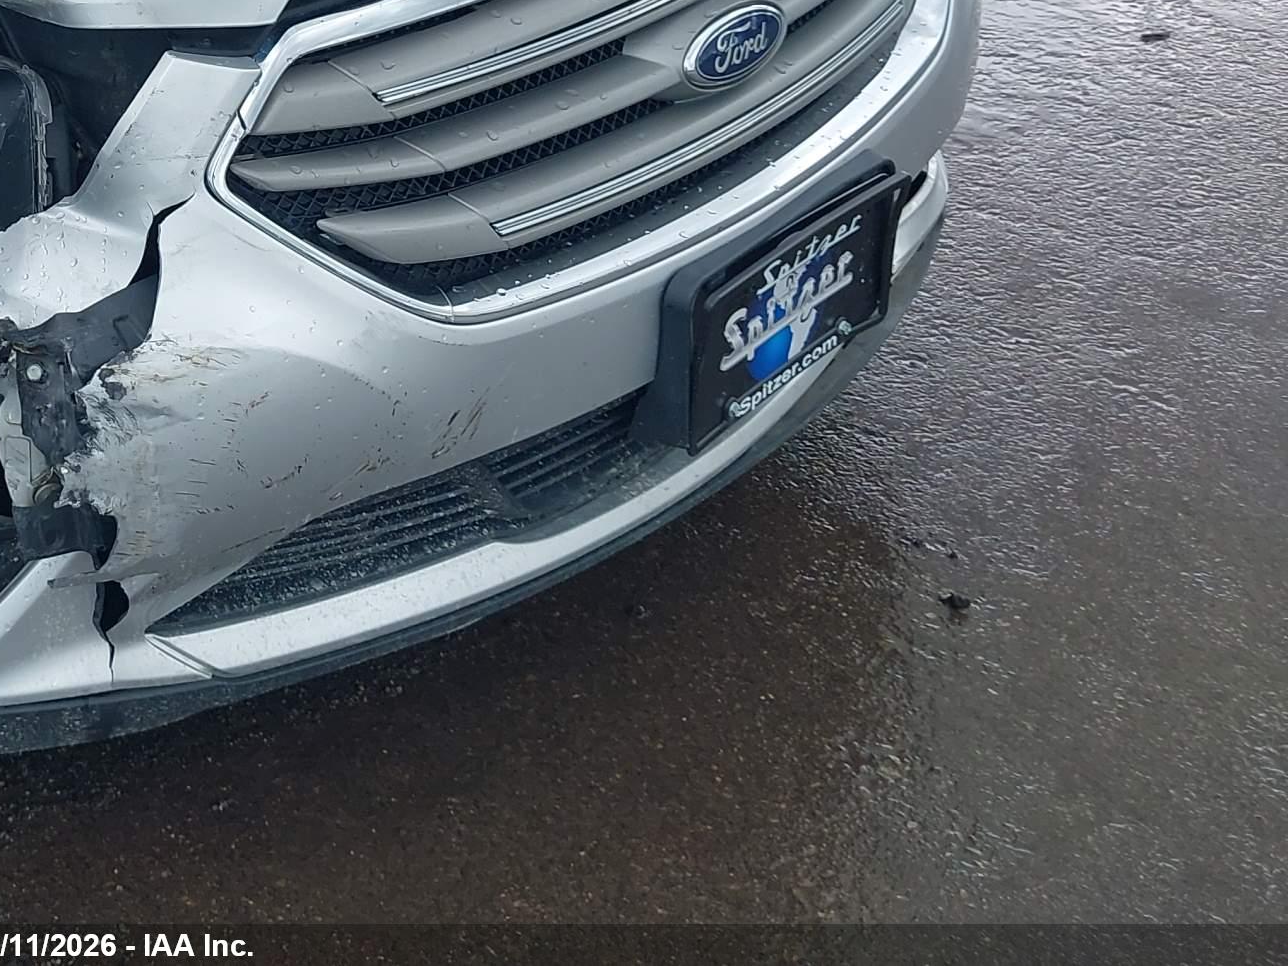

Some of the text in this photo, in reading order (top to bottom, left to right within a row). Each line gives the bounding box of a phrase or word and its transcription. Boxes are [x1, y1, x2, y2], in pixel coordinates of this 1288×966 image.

[714, 21, 768, 74] Ford
[756, 214, 862, 296] Spitzer
[736, 335, 839, 418] Spitzer.com
